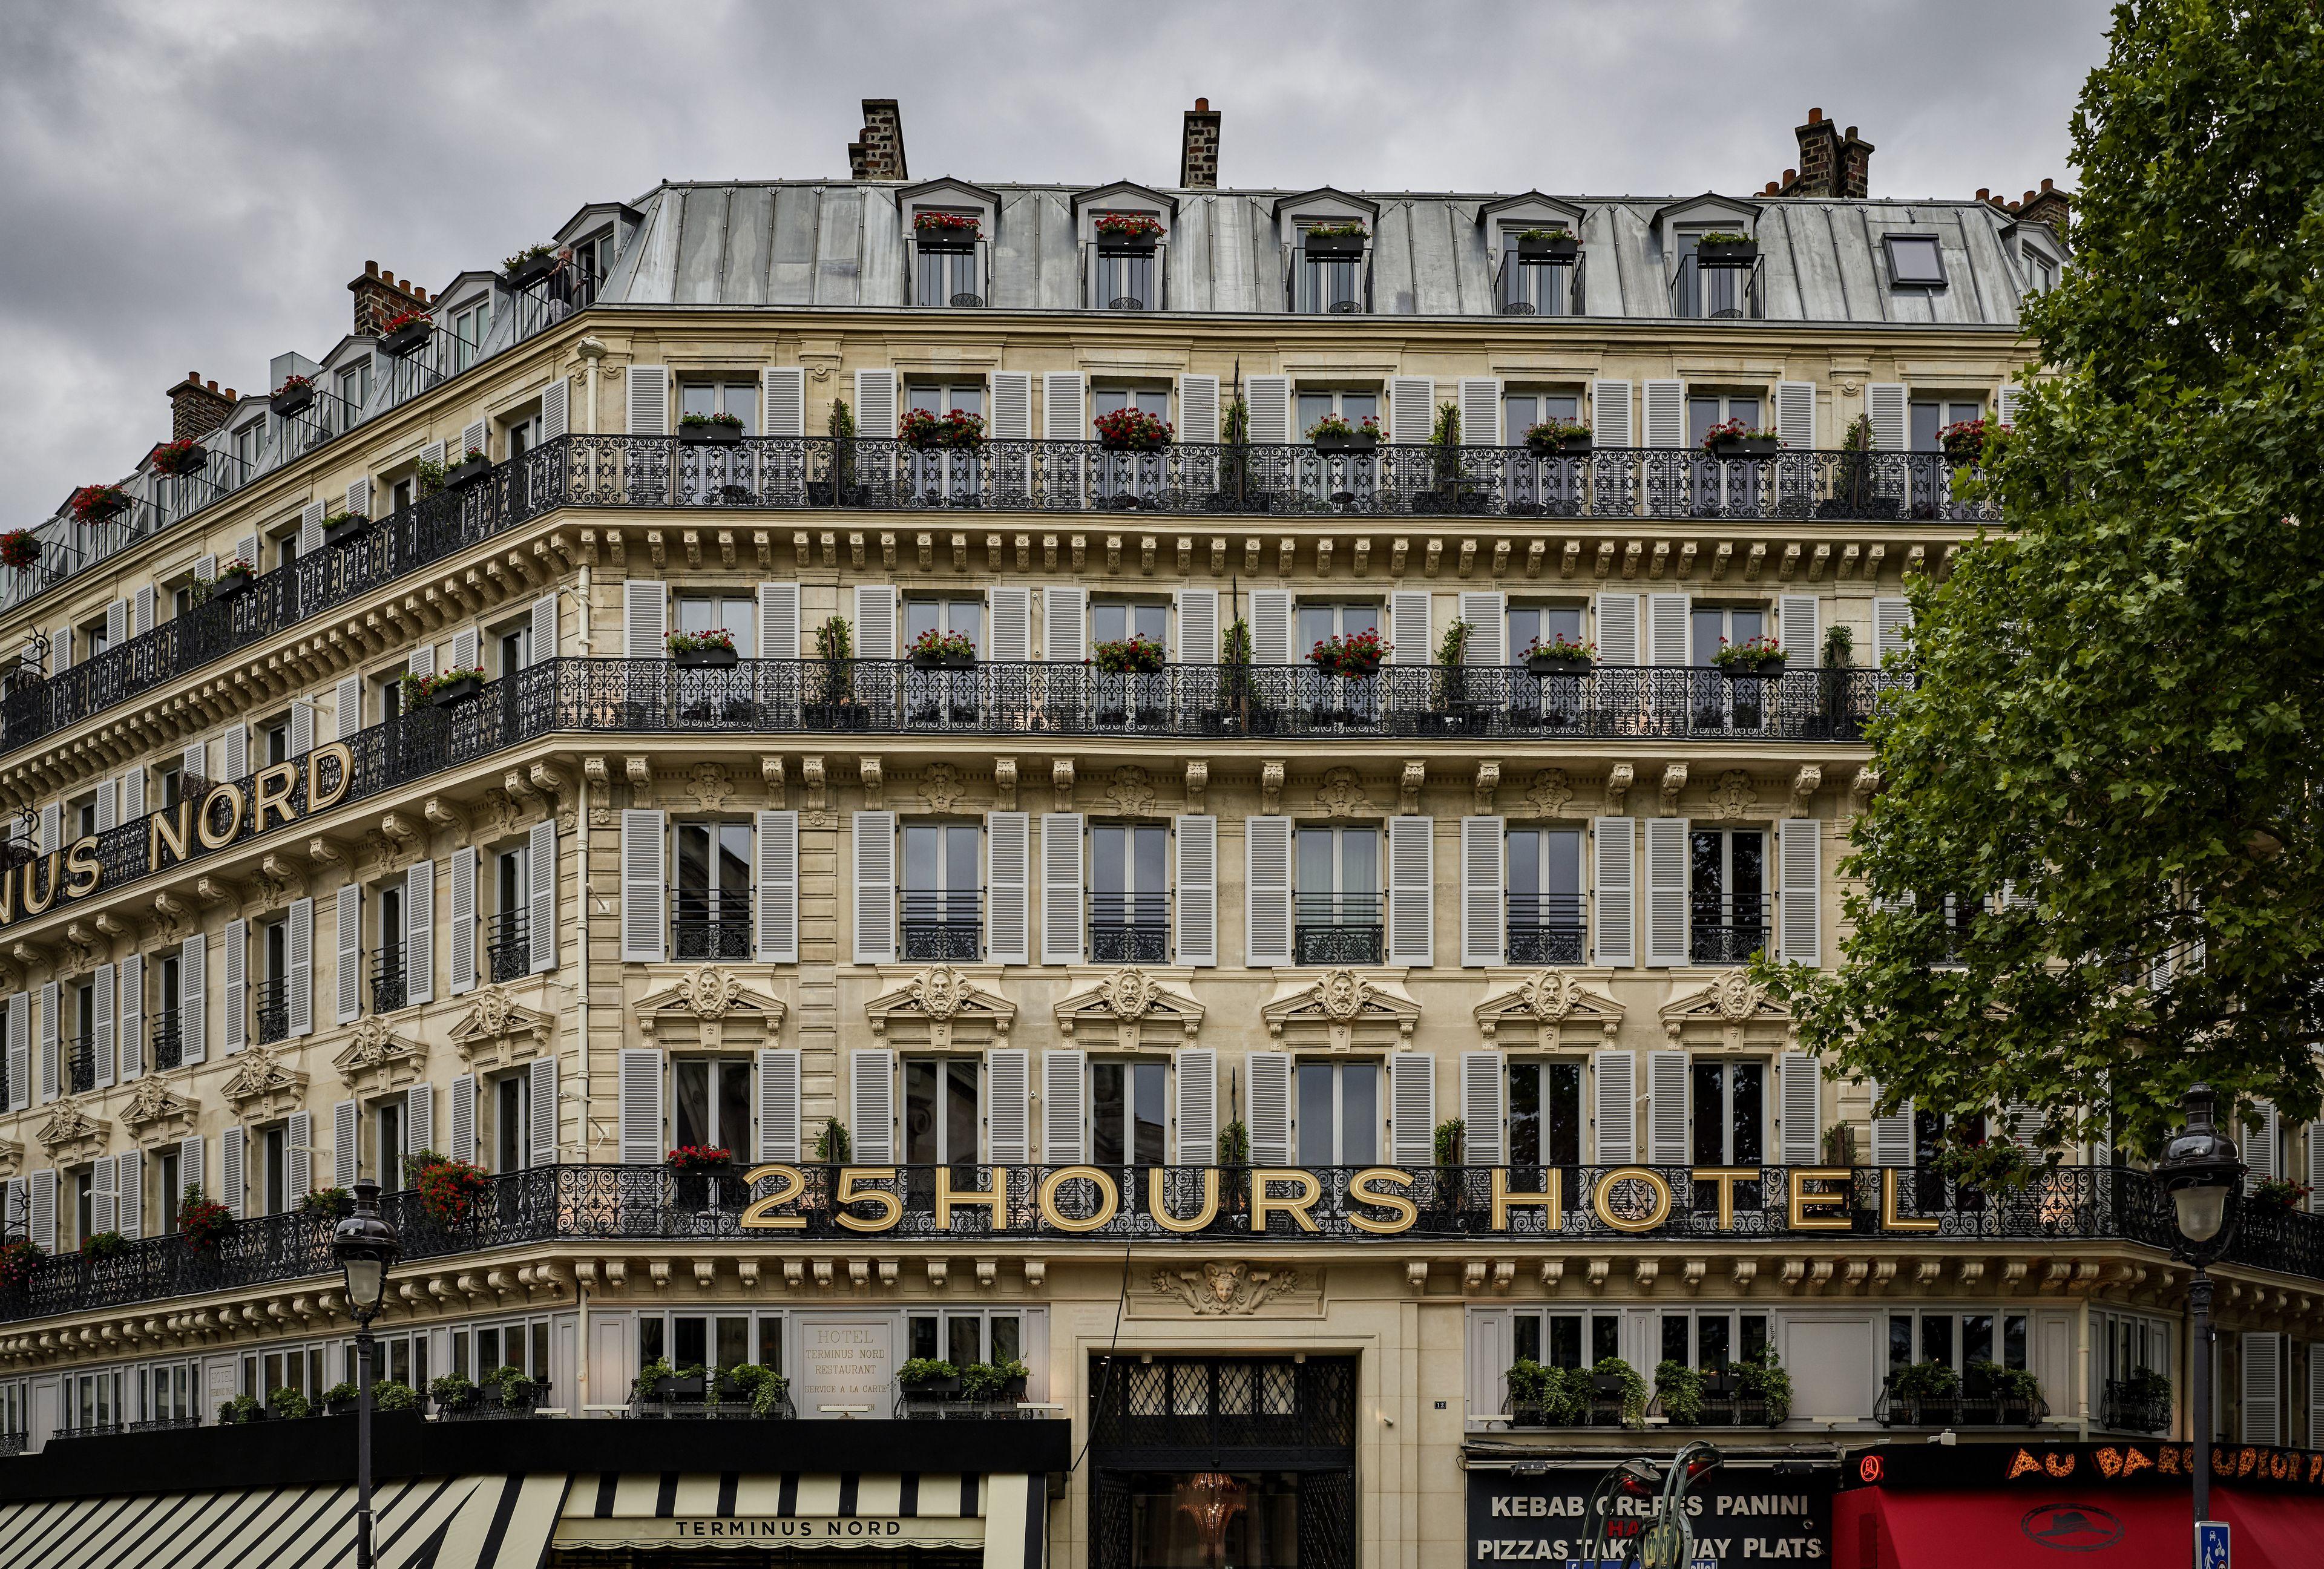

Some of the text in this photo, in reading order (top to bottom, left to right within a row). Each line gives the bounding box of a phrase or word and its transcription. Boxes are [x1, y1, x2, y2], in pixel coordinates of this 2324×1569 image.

[149, 741, 355, 872] NORD
[1491, 1165, 1940, 1232] HOTEL
[818, 1330, 873, 1343] HOTEL
[806, 1349, 885, 1359] TERMINUS NORD
[815, 1364, 876, 1374] RESTAURANT
[2007, 1447, 2076, 1479] AU
[1491, 1496, 1584, 1518] KEBAB
[1716, 1495, 1808, 1516] PANINI
[675, 1520, 901, 1536] TERMINUS NORD
[1477, 1539, 1569, 1561] PIZZAS
[1576, 1539, 1641, 1560] TAK
[1743, 1538, 1823, 1559] PLATS
